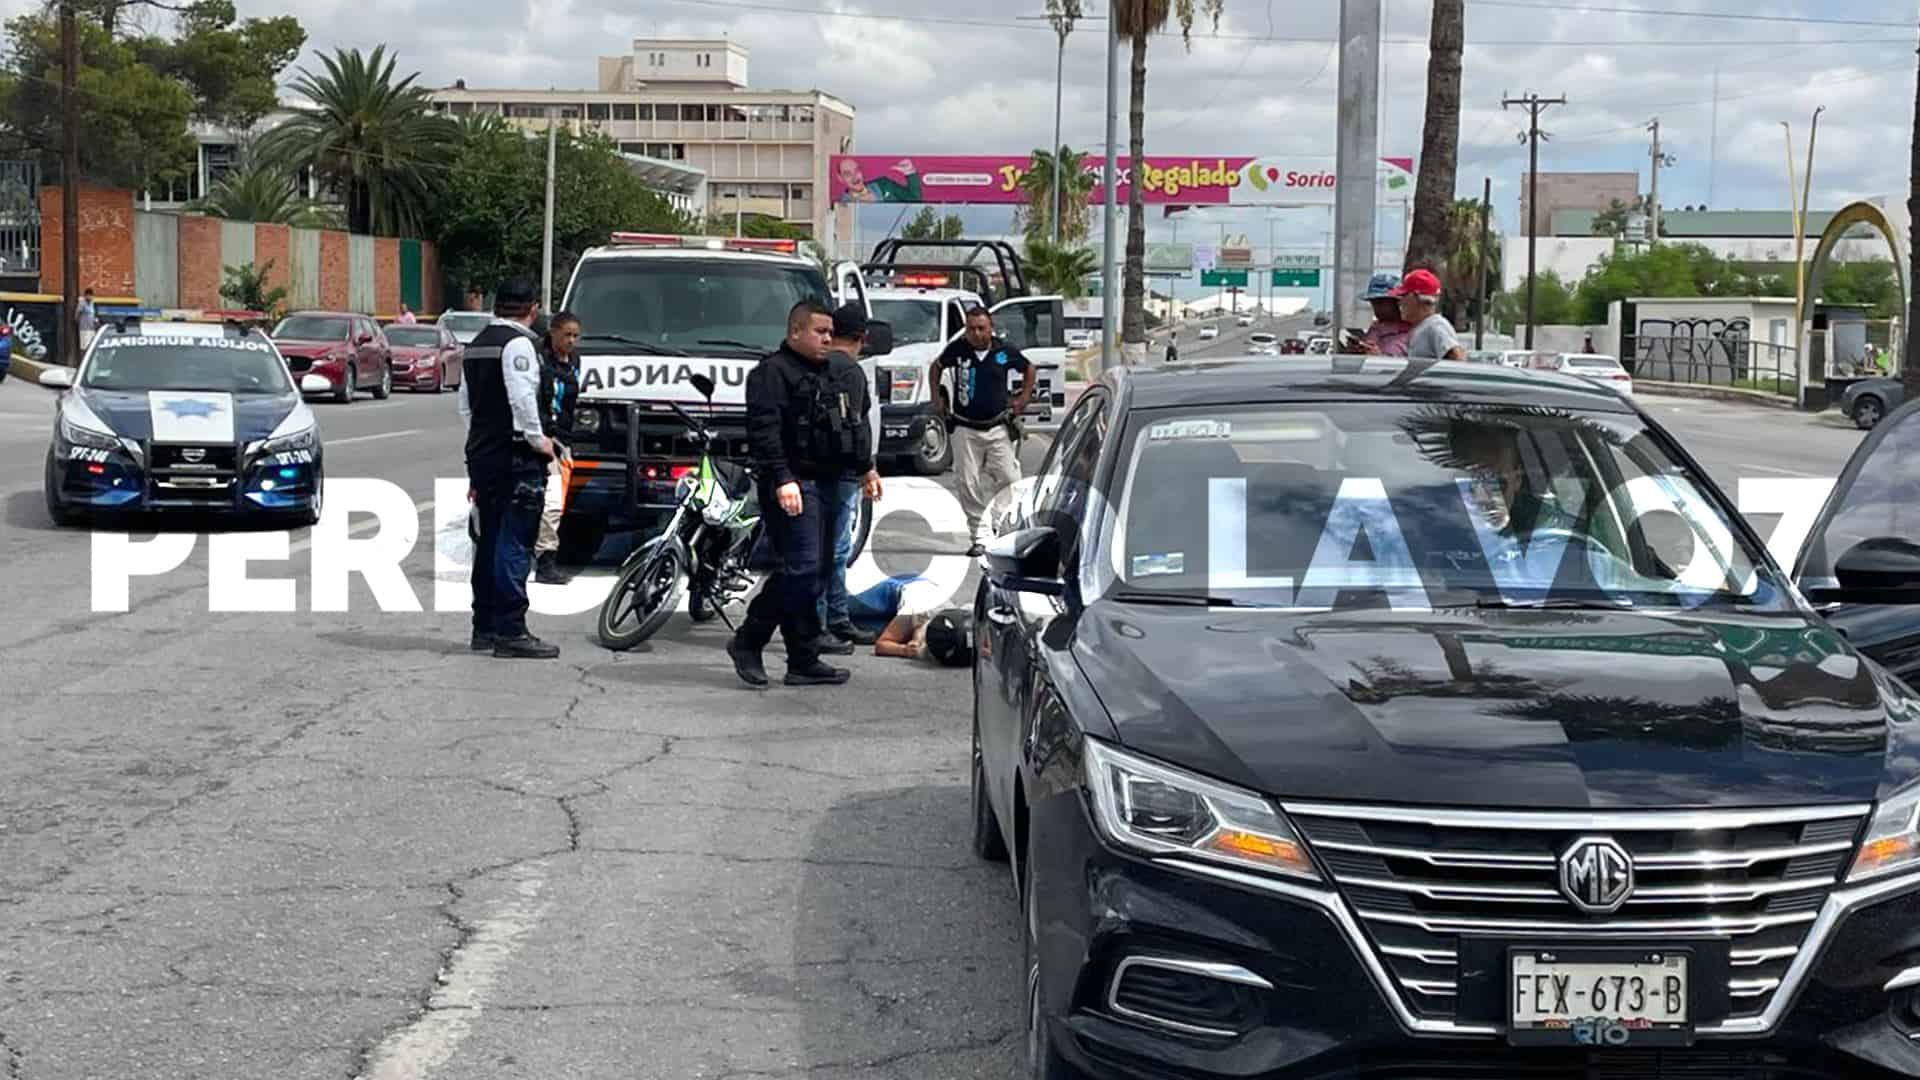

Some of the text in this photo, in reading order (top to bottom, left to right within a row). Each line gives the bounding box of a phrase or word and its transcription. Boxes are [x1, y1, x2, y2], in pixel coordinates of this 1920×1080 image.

[1286, 170, 1336, 188] Soria
[1568, 844, 1628, 904] MG
[1516, 975, 1681, 1014] FEX-673-B
